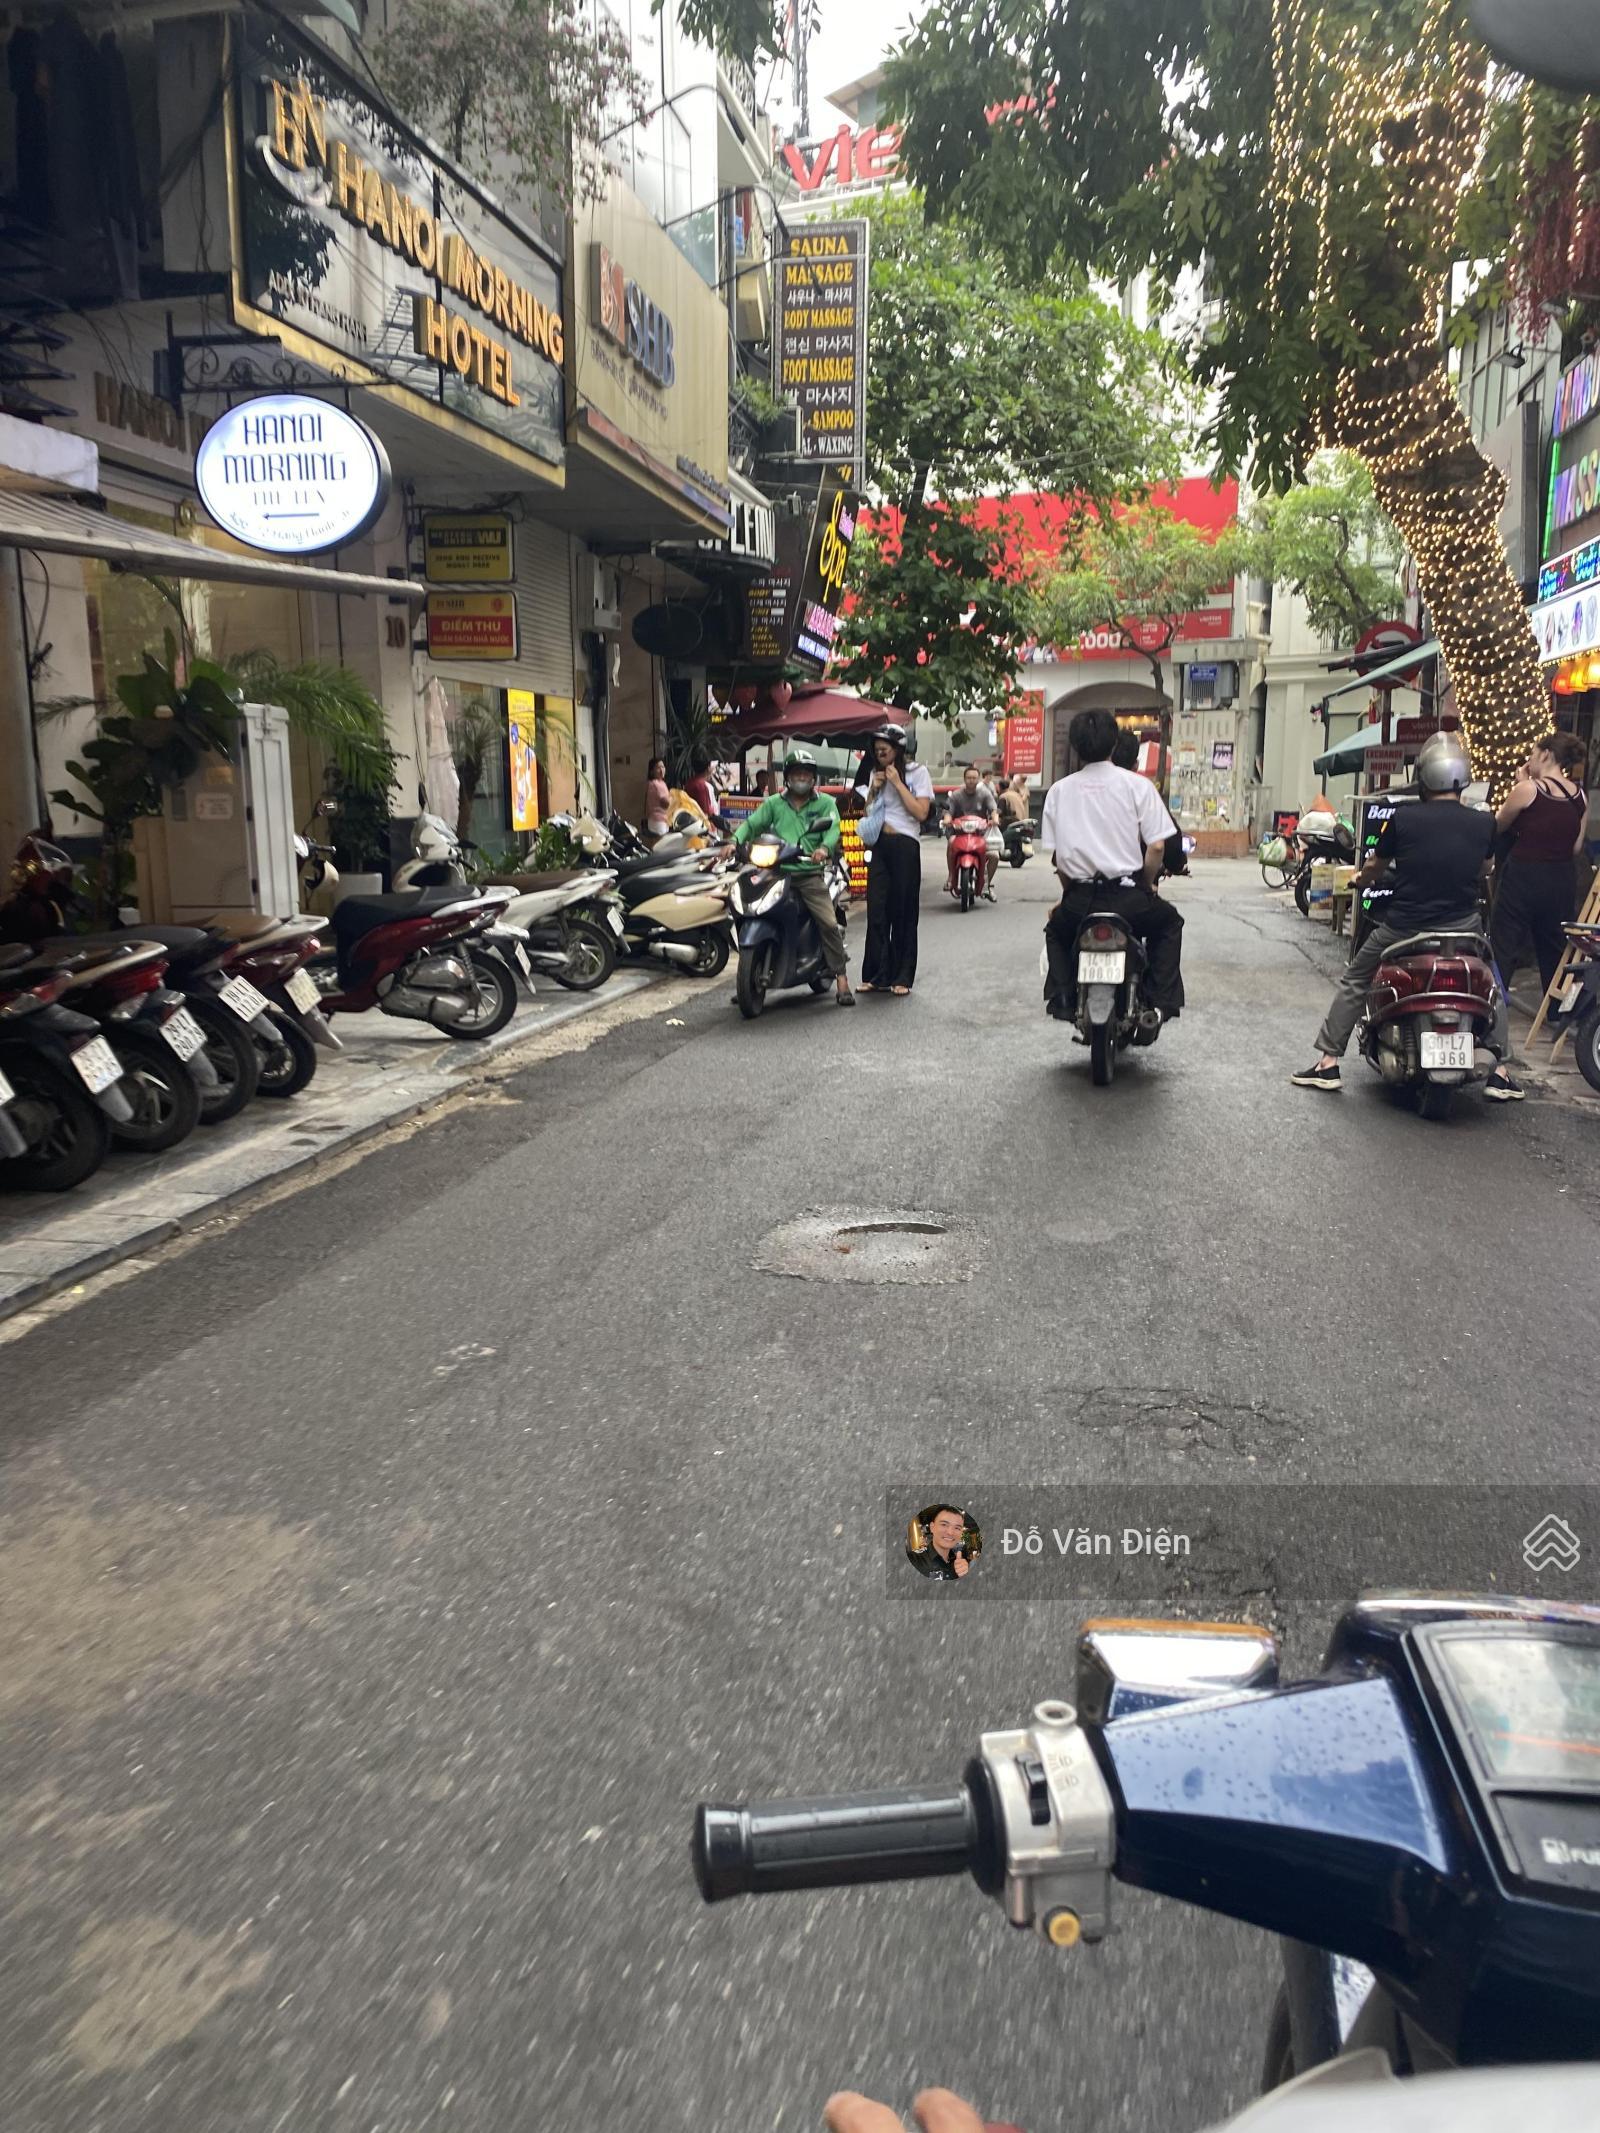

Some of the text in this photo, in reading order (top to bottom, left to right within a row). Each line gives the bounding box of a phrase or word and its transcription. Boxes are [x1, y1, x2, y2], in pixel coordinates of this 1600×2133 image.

[337, 140, 565, 365] HANOI MORNING
[790, 236, 849, 257] SAUNA
[824, 286, 853, 305] 마사지
[811, 307, 854, 328] MASSAGE
[627, 279, 676, 389] SHB
[815, 333, 853, 354] 마사지
[425, 299, 520, 406] HOTEL
[783, 356, 854, 383] FOOT MASSAGE
[806, 386, 852, 405] 마사지
[242, 413, 323, 445] HANOI
[813, 409, 854, 430] SAMPOO
[818, 436, 853, 456] WAXING
[223, 451, 346, 484] MORNING
[386, 615, 406, 648] 10
[475, 621, 501, 632] THU
[1371, 762, 1398, 771] MONEY
[1367, 805, 1396, 820] Bar
[844, 851, 864, 862] FOOT
[1429, 1052, 1466, 1066] 1968
